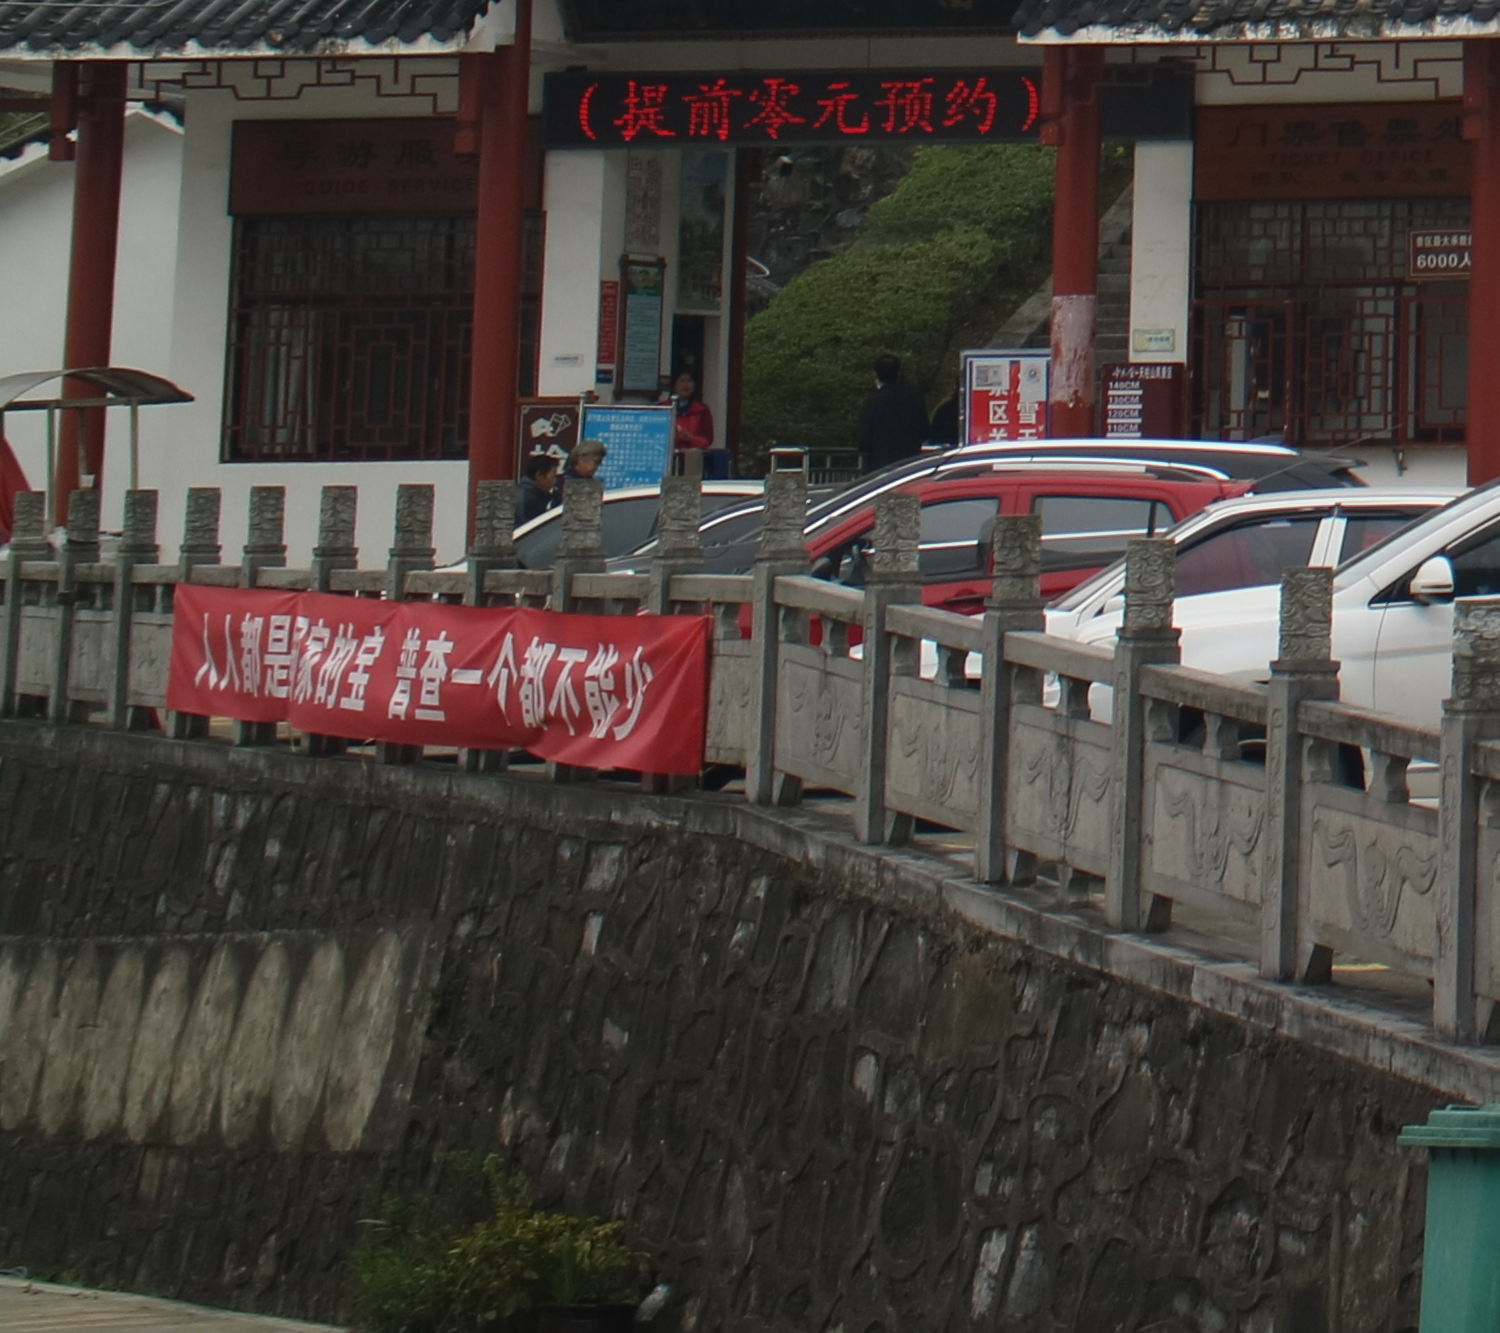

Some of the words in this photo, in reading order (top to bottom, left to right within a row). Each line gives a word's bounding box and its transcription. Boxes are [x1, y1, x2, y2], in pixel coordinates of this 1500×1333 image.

[1416, 251, 1472, 269] 6000人
[387, 627, 654, 742] 普查一个都不能少
